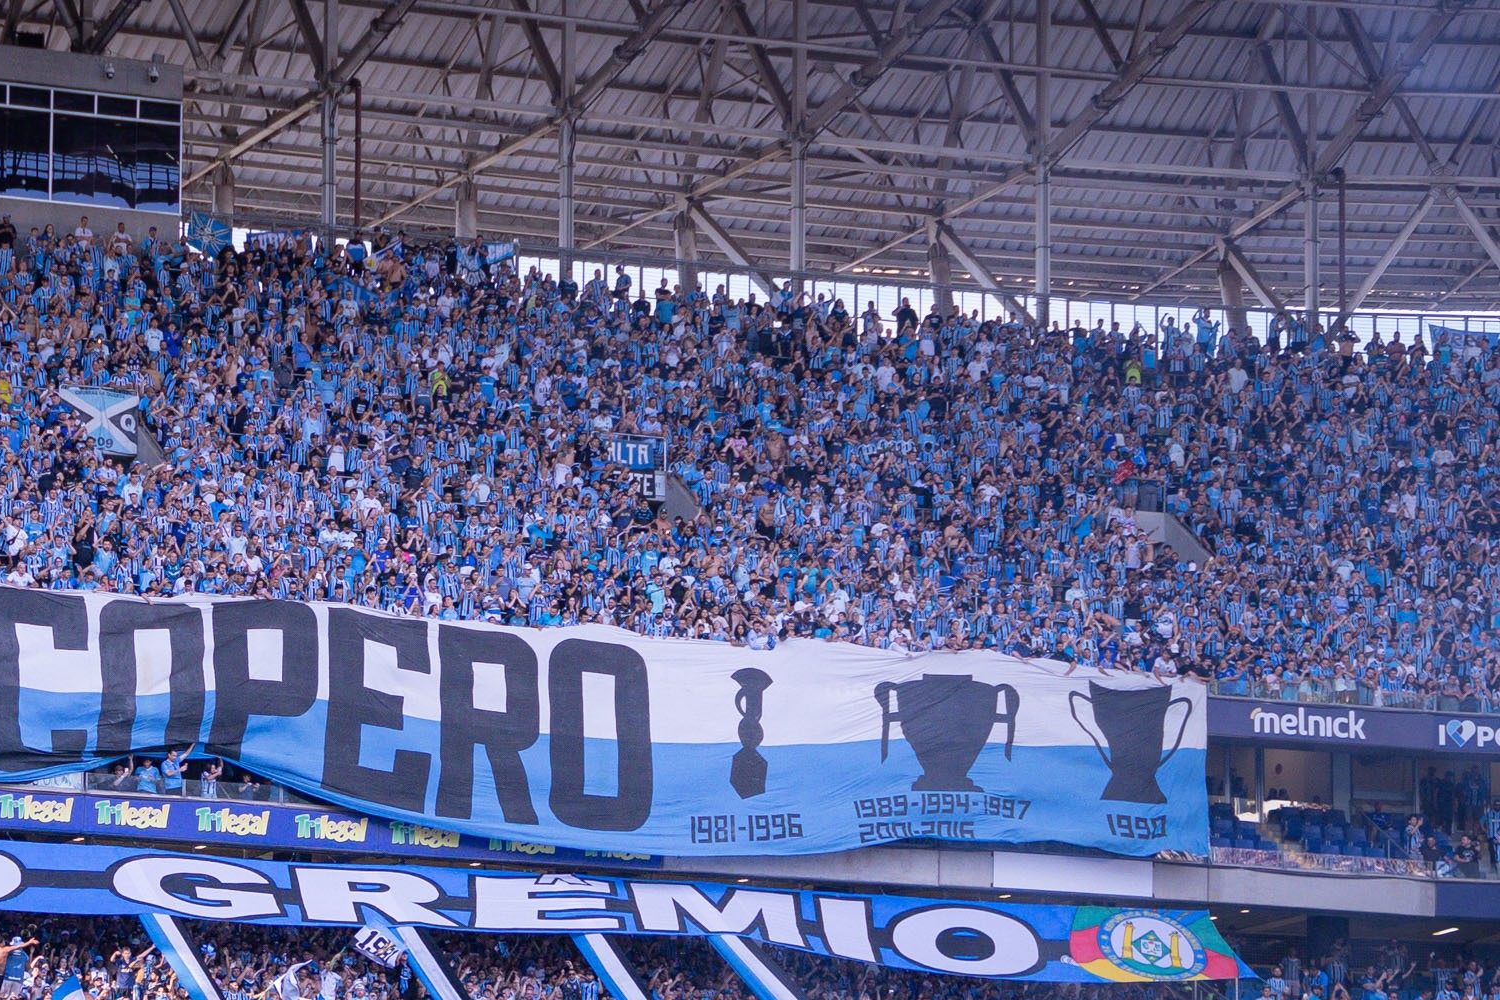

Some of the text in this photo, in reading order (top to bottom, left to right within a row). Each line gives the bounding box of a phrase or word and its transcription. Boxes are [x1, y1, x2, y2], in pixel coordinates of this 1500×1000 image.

[1251, 707, 1366, 740] melnick
[95, 799, 170, 829] Trilegal
[196, 807, 270, 837] Trilegal
[294, 814, 368, 843] Trilegal
[690, 814, 804, 844] 1981-1996
[1106, 813, 1167, 841] 1990
[114, 855, 1039, 976] GRÊMIO
